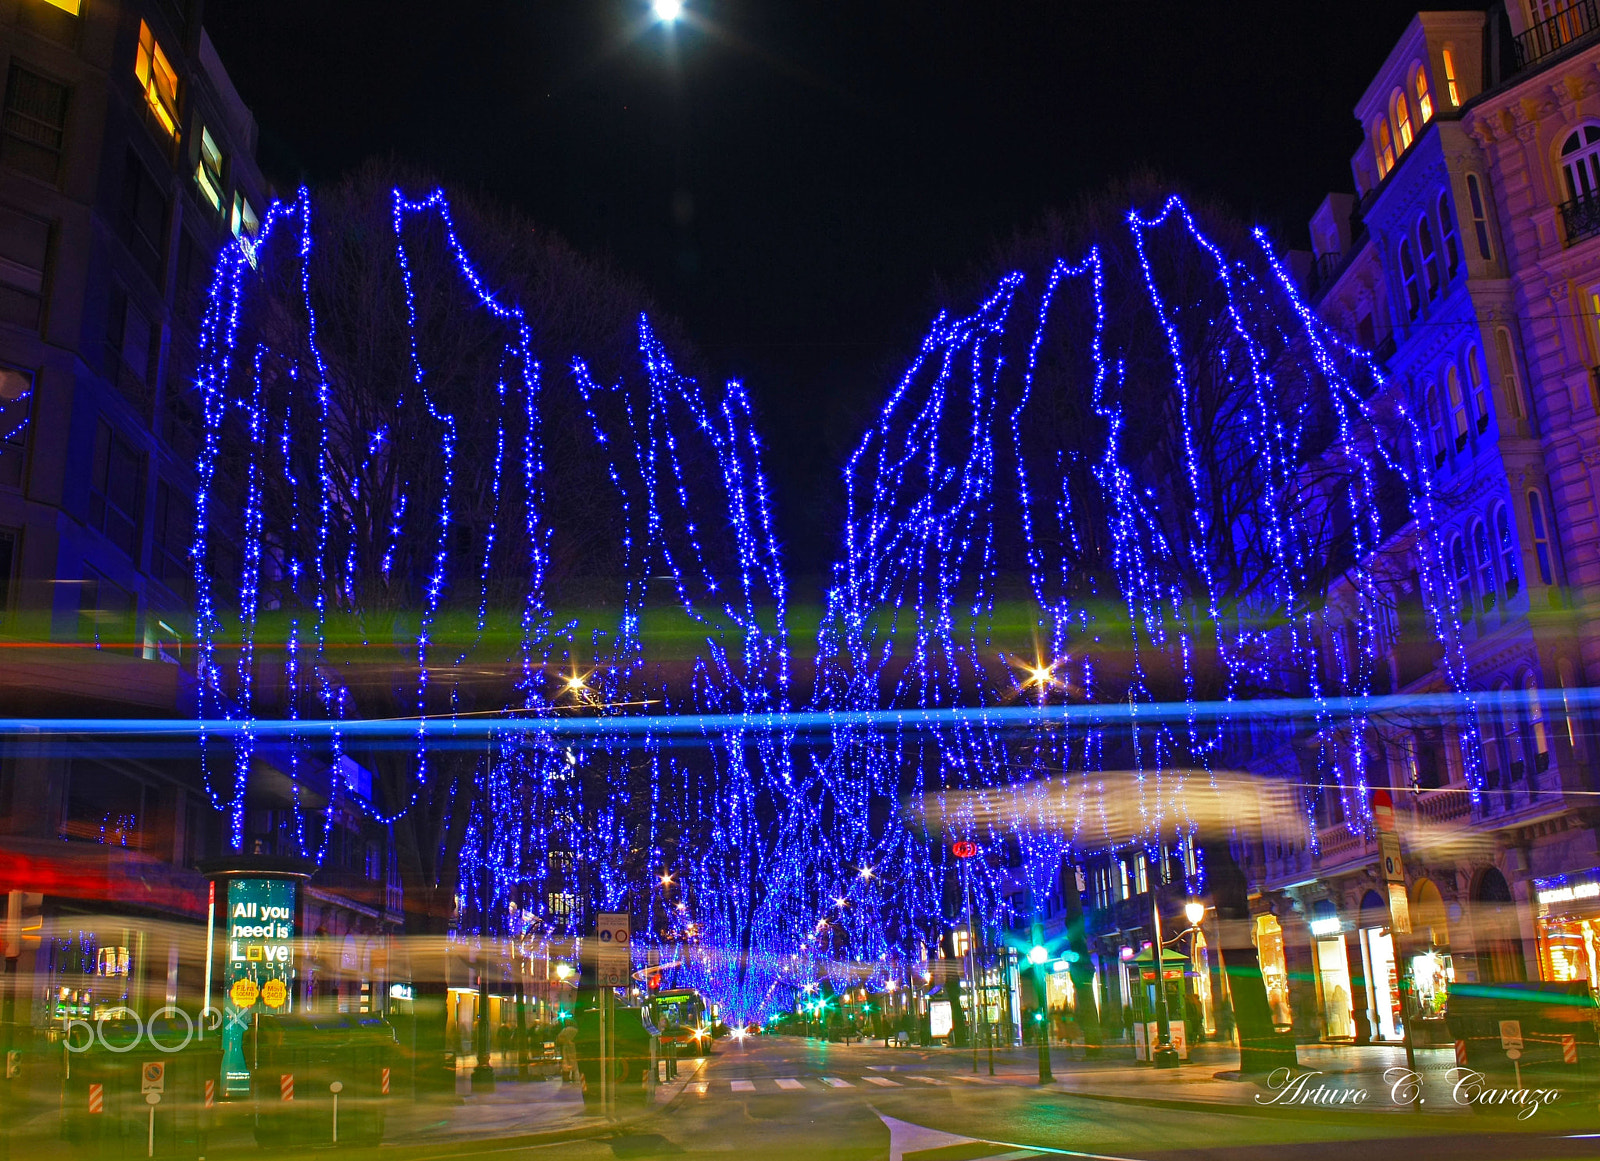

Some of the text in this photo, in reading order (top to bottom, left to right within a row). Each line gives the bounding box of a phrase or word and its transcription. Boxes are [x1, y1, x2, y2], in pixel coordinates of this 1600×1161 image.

[233, 902, 289, 921] All you
[231, 922, 289, 939] need is
